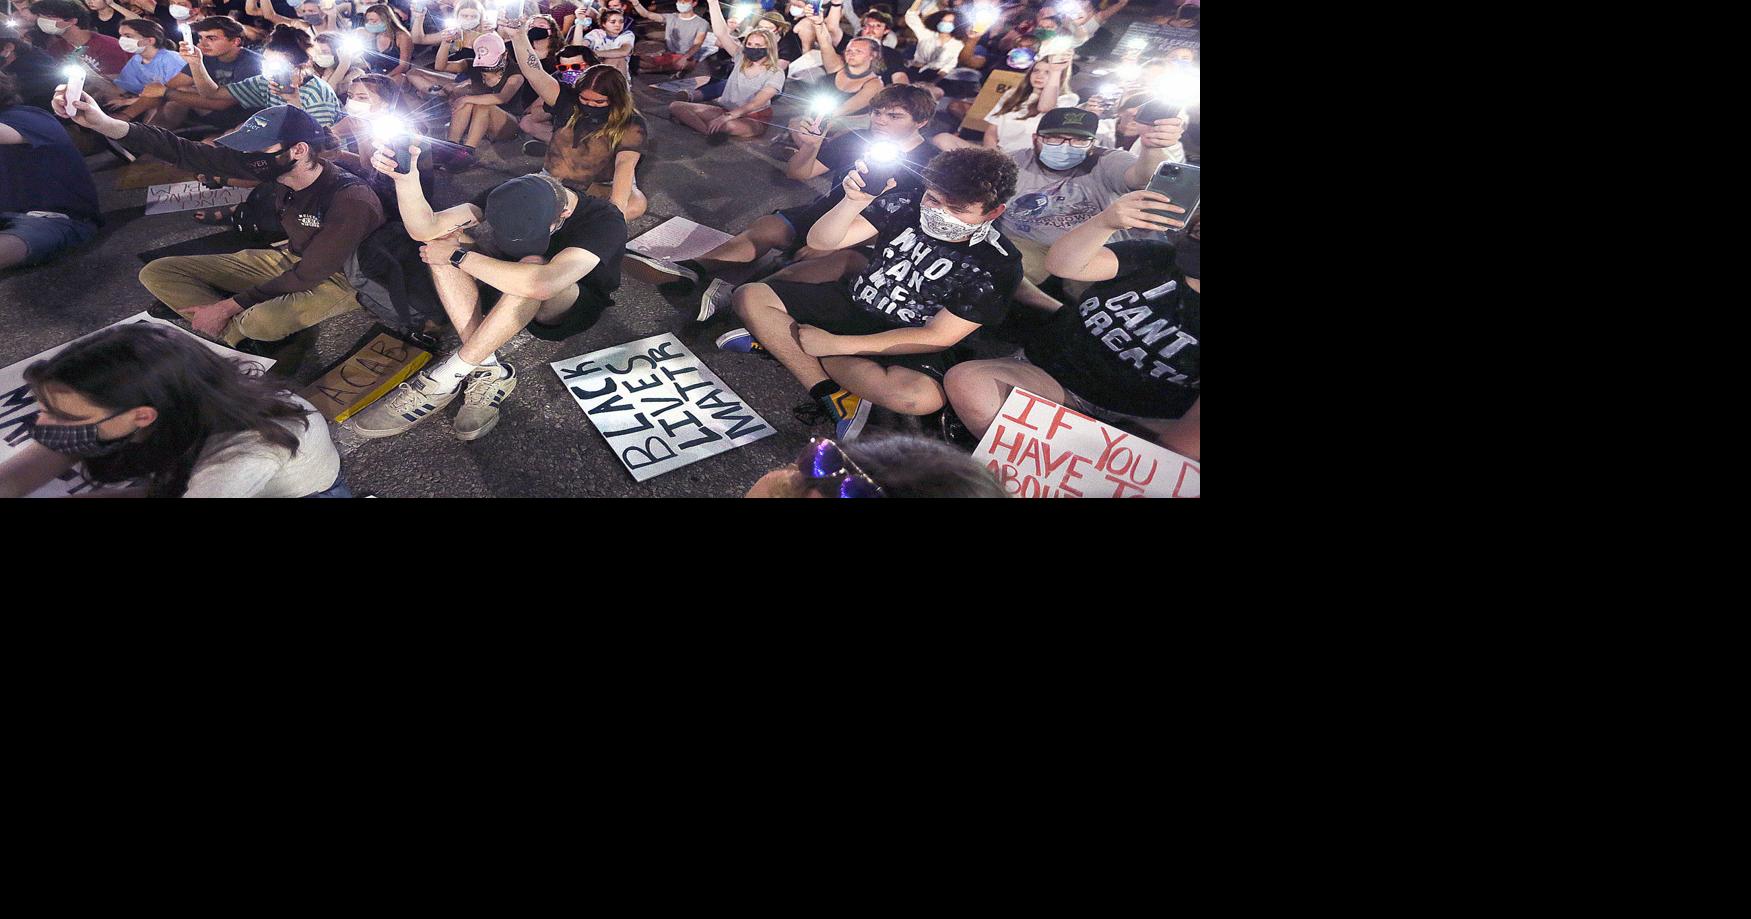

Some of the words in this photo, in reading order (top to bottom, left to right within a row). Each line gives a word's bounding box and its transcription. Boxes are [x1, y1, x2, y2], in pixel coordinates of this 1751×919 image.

[890, 227, 953, 281] WHO
[1142, 279, 1177, 300] I
[316, 340, 408, 406] ACAB
[605, 354, 723, 450] LIVES
[560, 360, 679, 470] BLACK
[1001, 389, 1097, 440] IF
[1094, 426, 1158, 486] YOU
[988, 424, 1093, 498] HAVE
[1104, 474, 1146, 498] T
